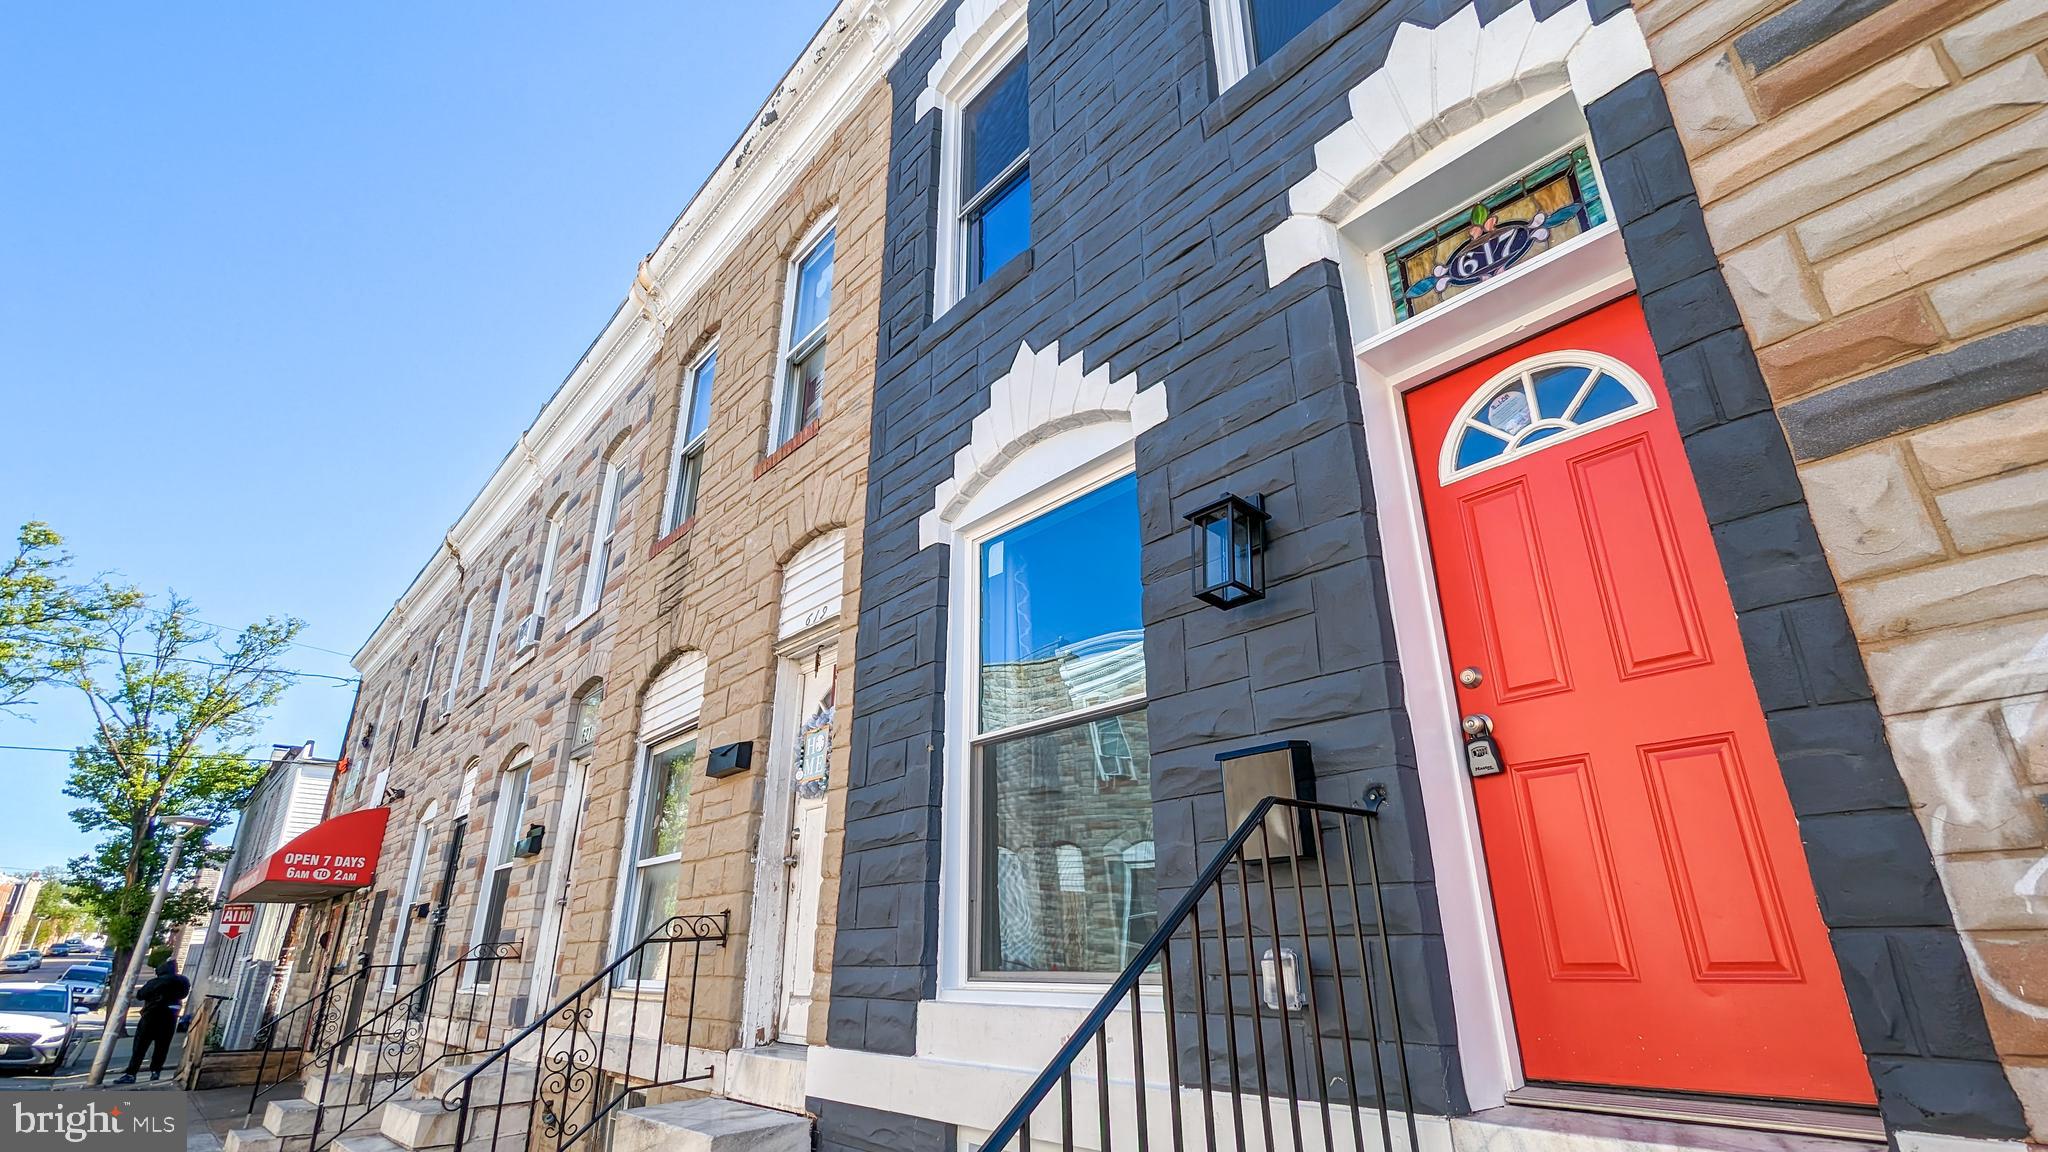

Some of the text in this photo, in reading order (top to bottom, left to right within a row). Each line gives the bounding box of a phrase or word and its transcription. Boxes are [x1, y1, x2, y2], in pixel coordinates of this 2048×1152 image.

[1457, 227, 1519, 278] 617
[805, 606, 828, 626] 619
[284, 852, 366, 868] OPEN 7 DAYS
[286, 867, 310, 879] 6AM
[333, 869, 357, 881] 2AM
[222, 910, 252, 922] ATM
